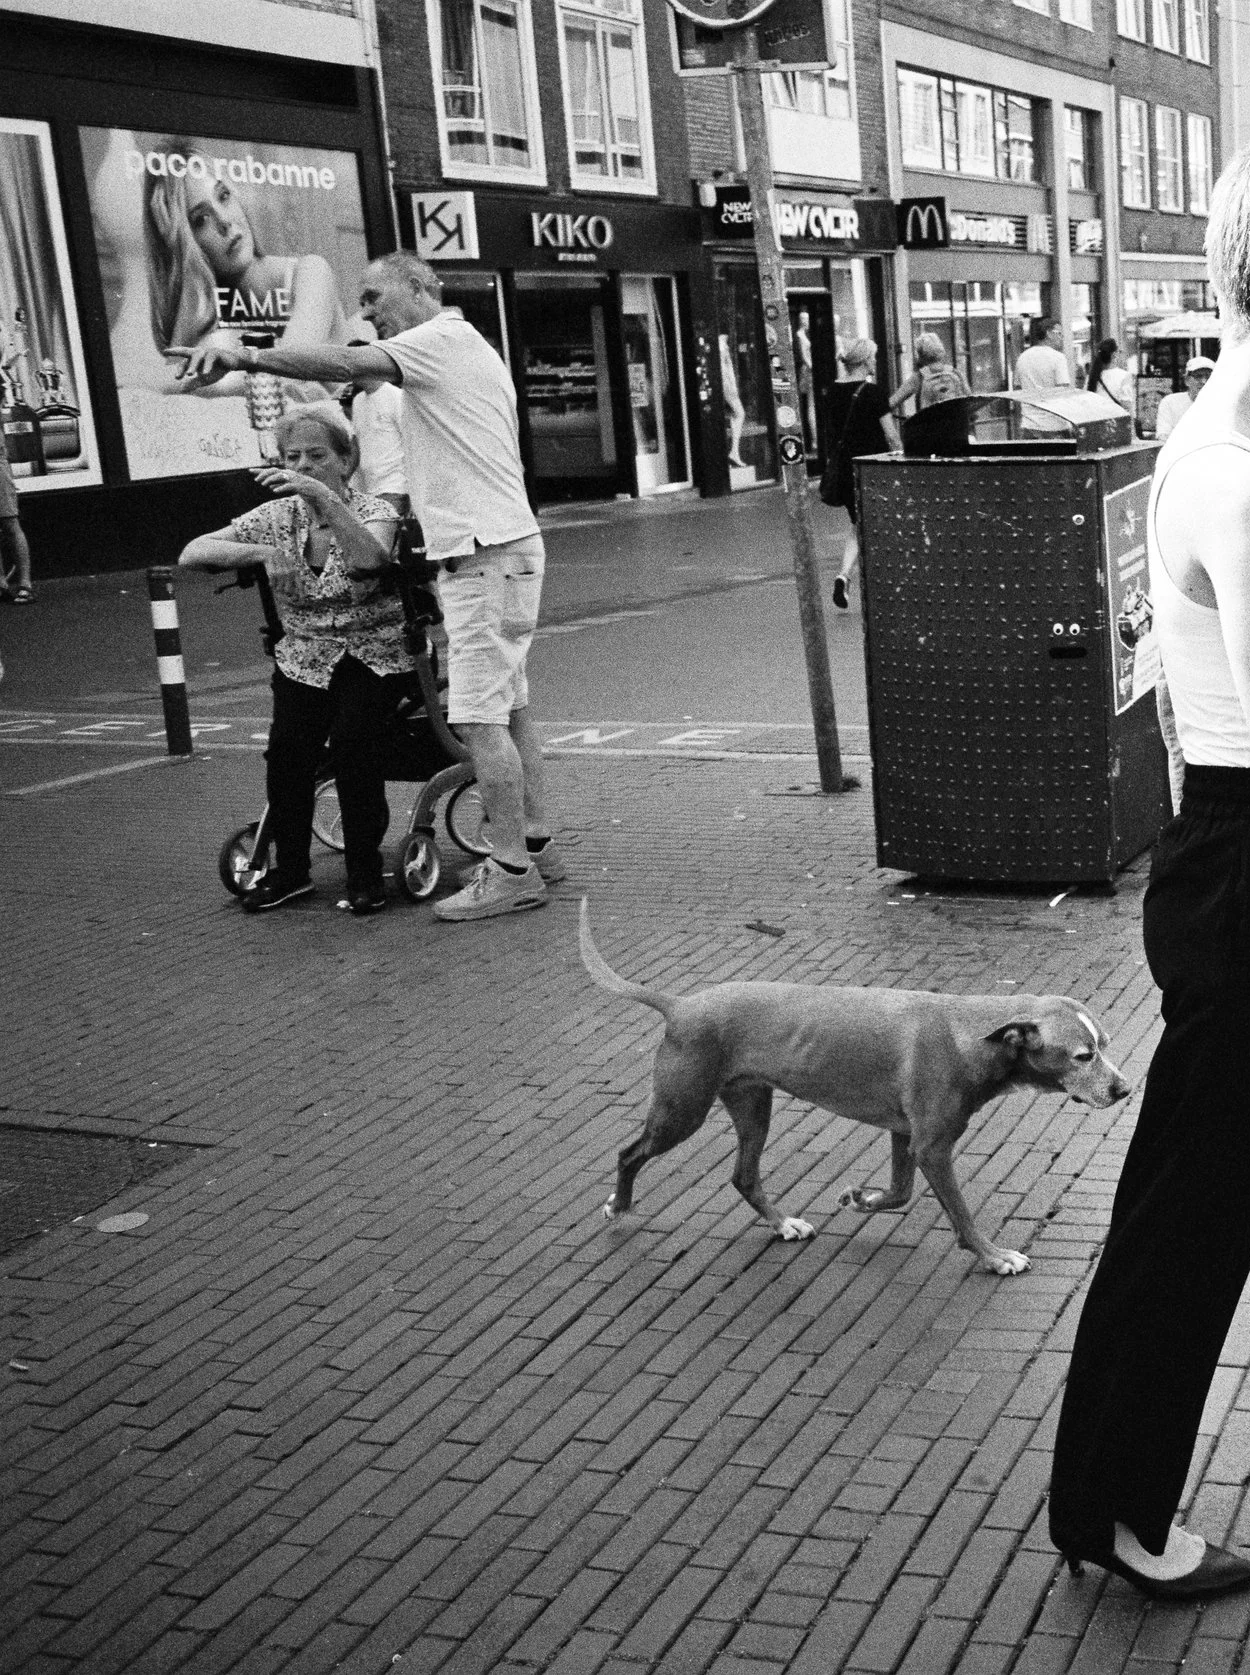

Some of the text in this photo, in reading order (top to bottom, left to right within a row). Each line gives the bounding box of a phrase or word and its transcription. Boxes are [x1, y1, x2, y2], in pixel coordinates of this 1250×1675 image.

[126, 150, 336, 190] paco rabanne
[723, 201, 752, 213] NEW
[531, 212, 614, 249] KIKO
[213, 287, 291, 318] FAME
